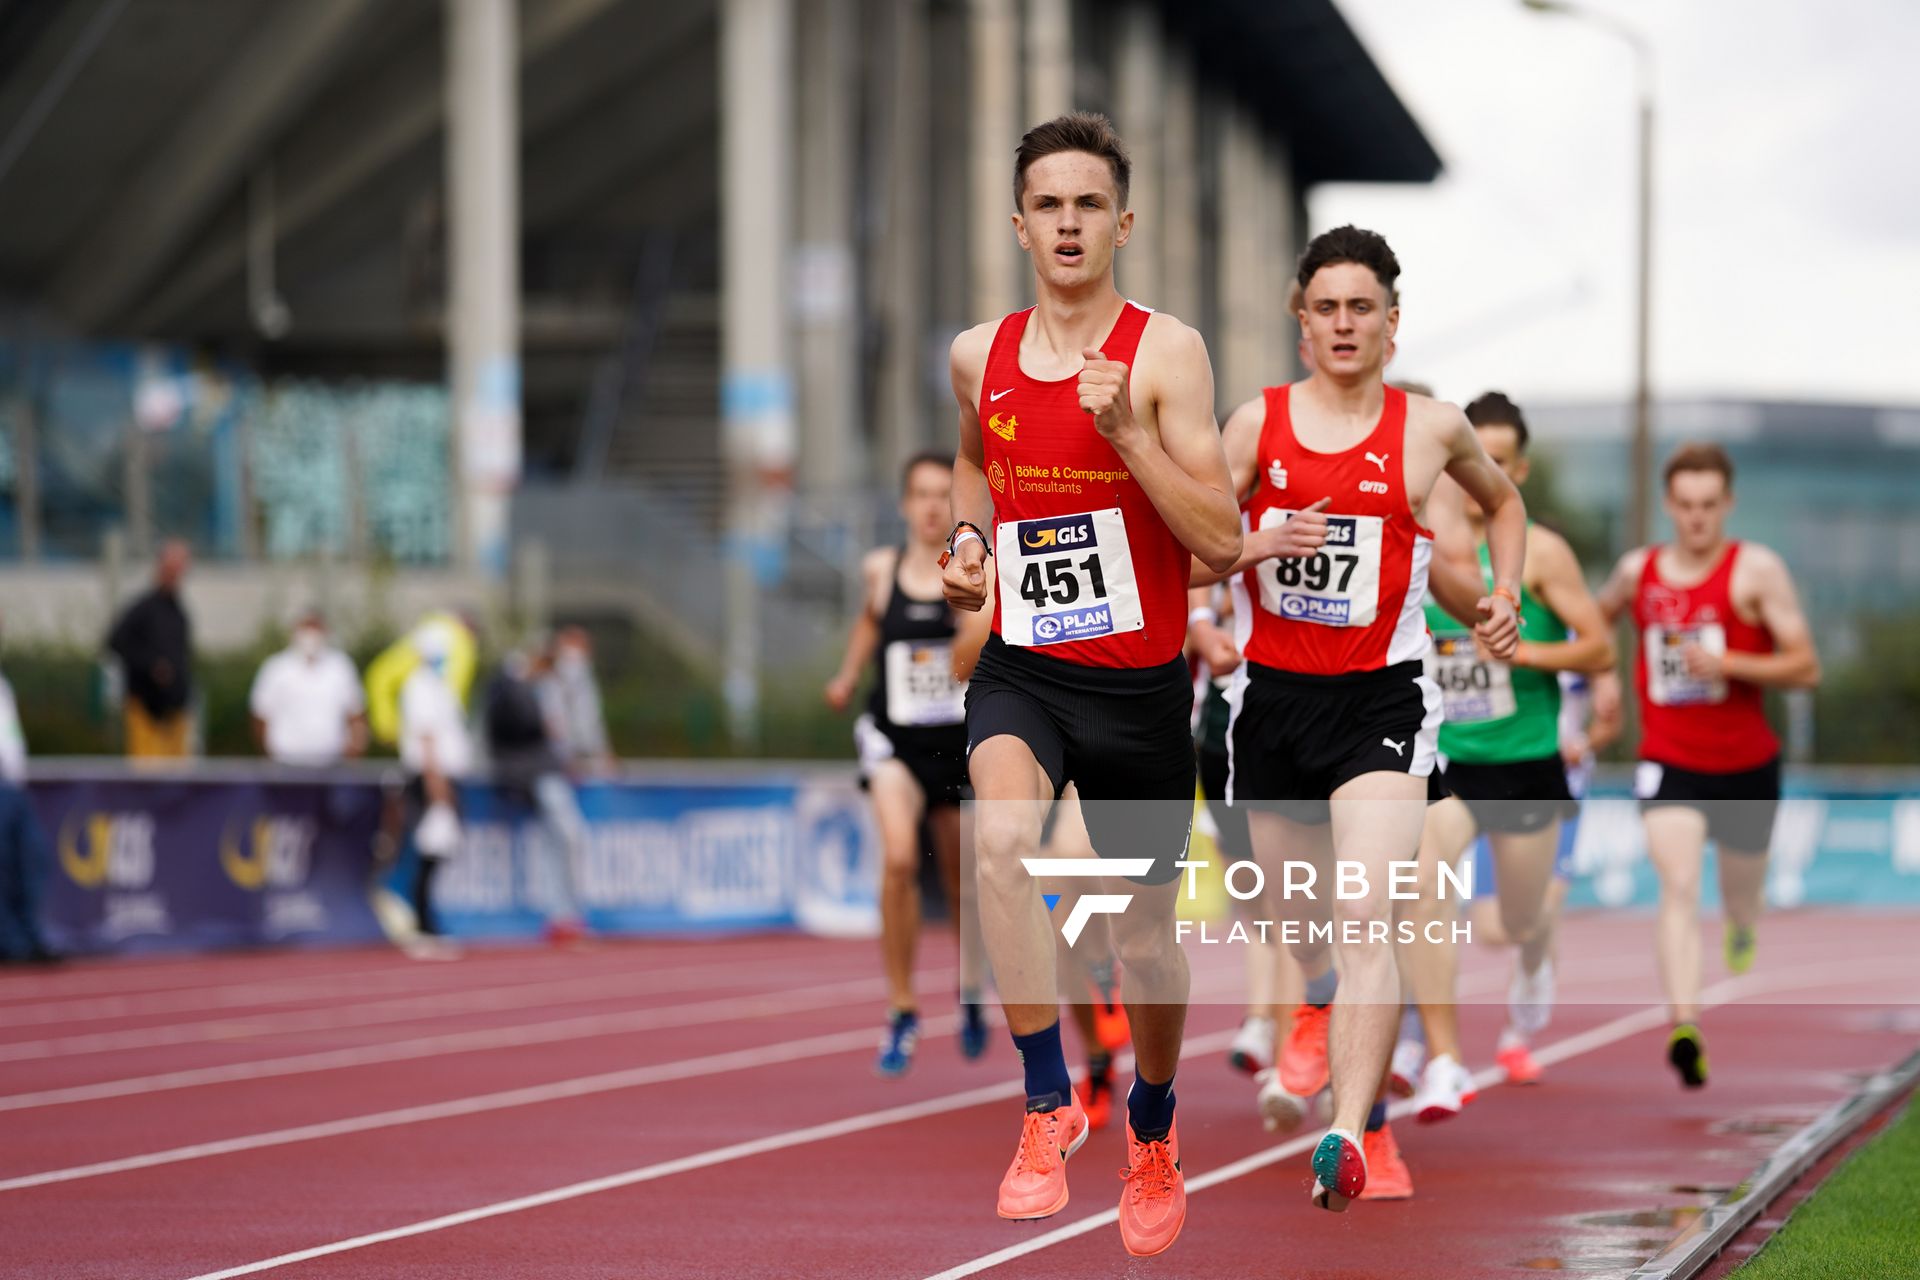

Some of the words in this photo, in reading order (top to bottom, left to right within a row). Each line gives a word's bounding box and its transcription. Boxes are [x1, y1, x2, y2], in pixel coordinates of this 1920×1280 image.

[1015, 465, 1049, 478] Böhke
[1052, 466, 1061, 478] &
[1063, 467, 1129, 483] Compagnie
[1019, 480, 1082, 494] Consultants
[1057, 525, 1088, 544] GLS
[1020, 553, 1107, 608] 451
[1276, 552, 1359, 592] 897
[1308, 600, 1348, 616] PLAN
[1063, 610, 1108, 629] PLAN
[1065, 624, 1109, 636] INTERNATIONAL
